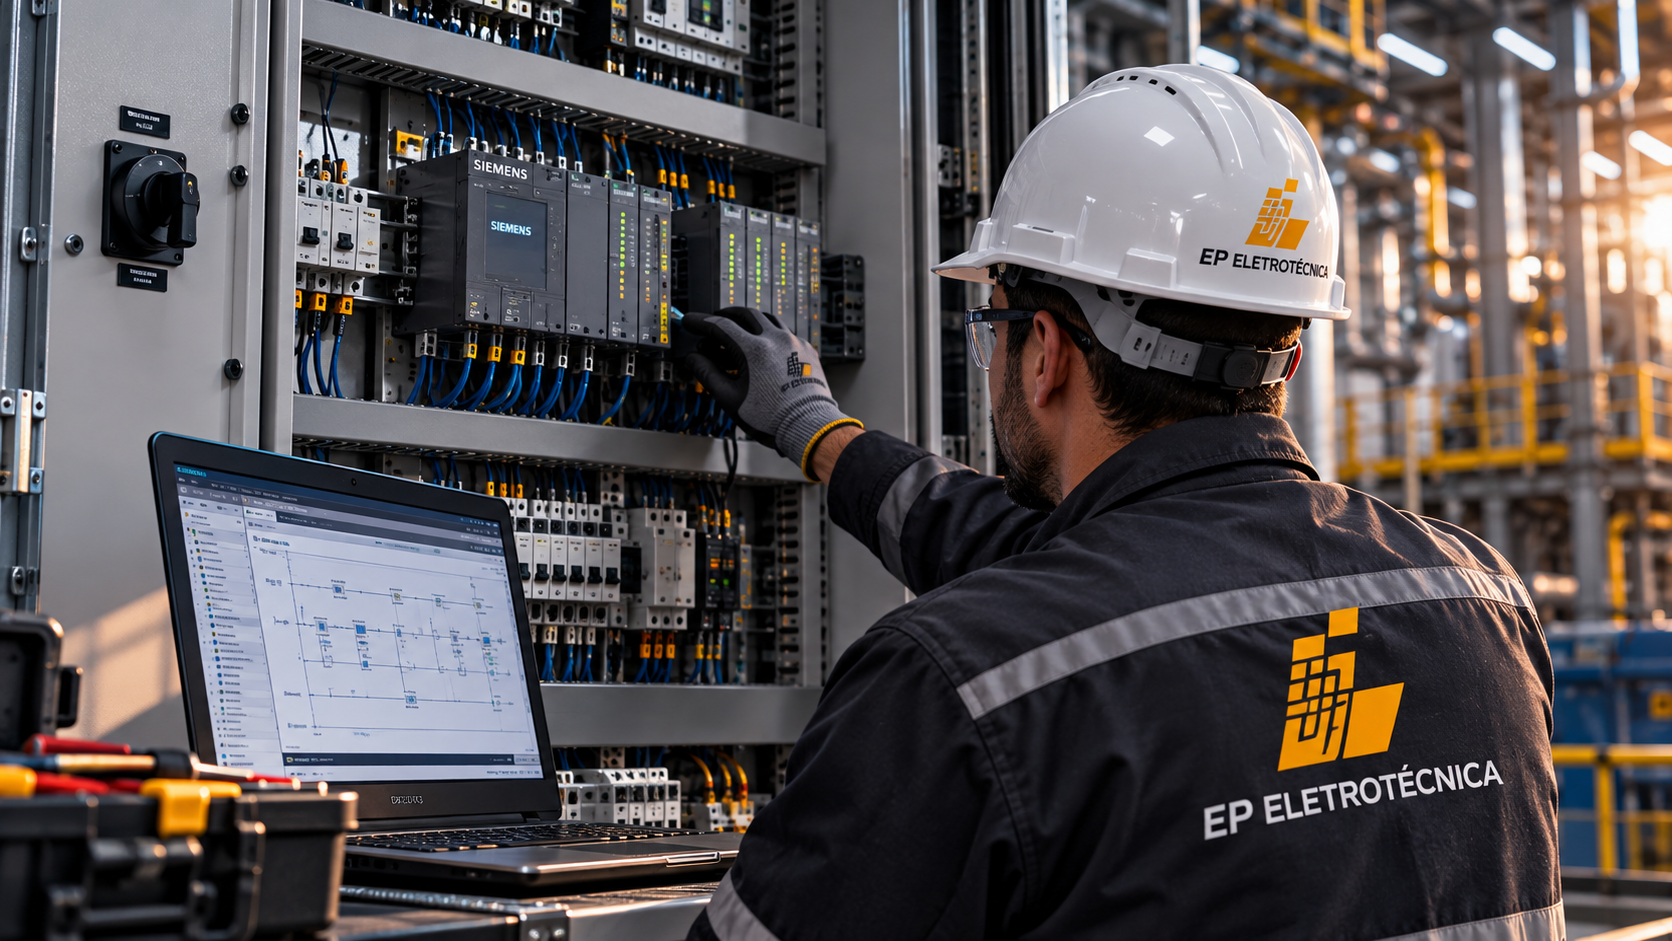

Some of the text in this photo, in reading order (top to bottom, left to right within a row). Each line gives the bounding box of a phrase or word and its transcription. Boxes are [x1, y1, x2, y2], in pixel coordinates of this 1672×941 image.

[474, 159, 528, 180] SIEMENS
[490, 220, 532, 236] SIEMENS
[1199, 248, 1328, 278] EP ELETROTÉCNICA
[1204, 760, 1504, 840] EP ELETROTÉCNICA
